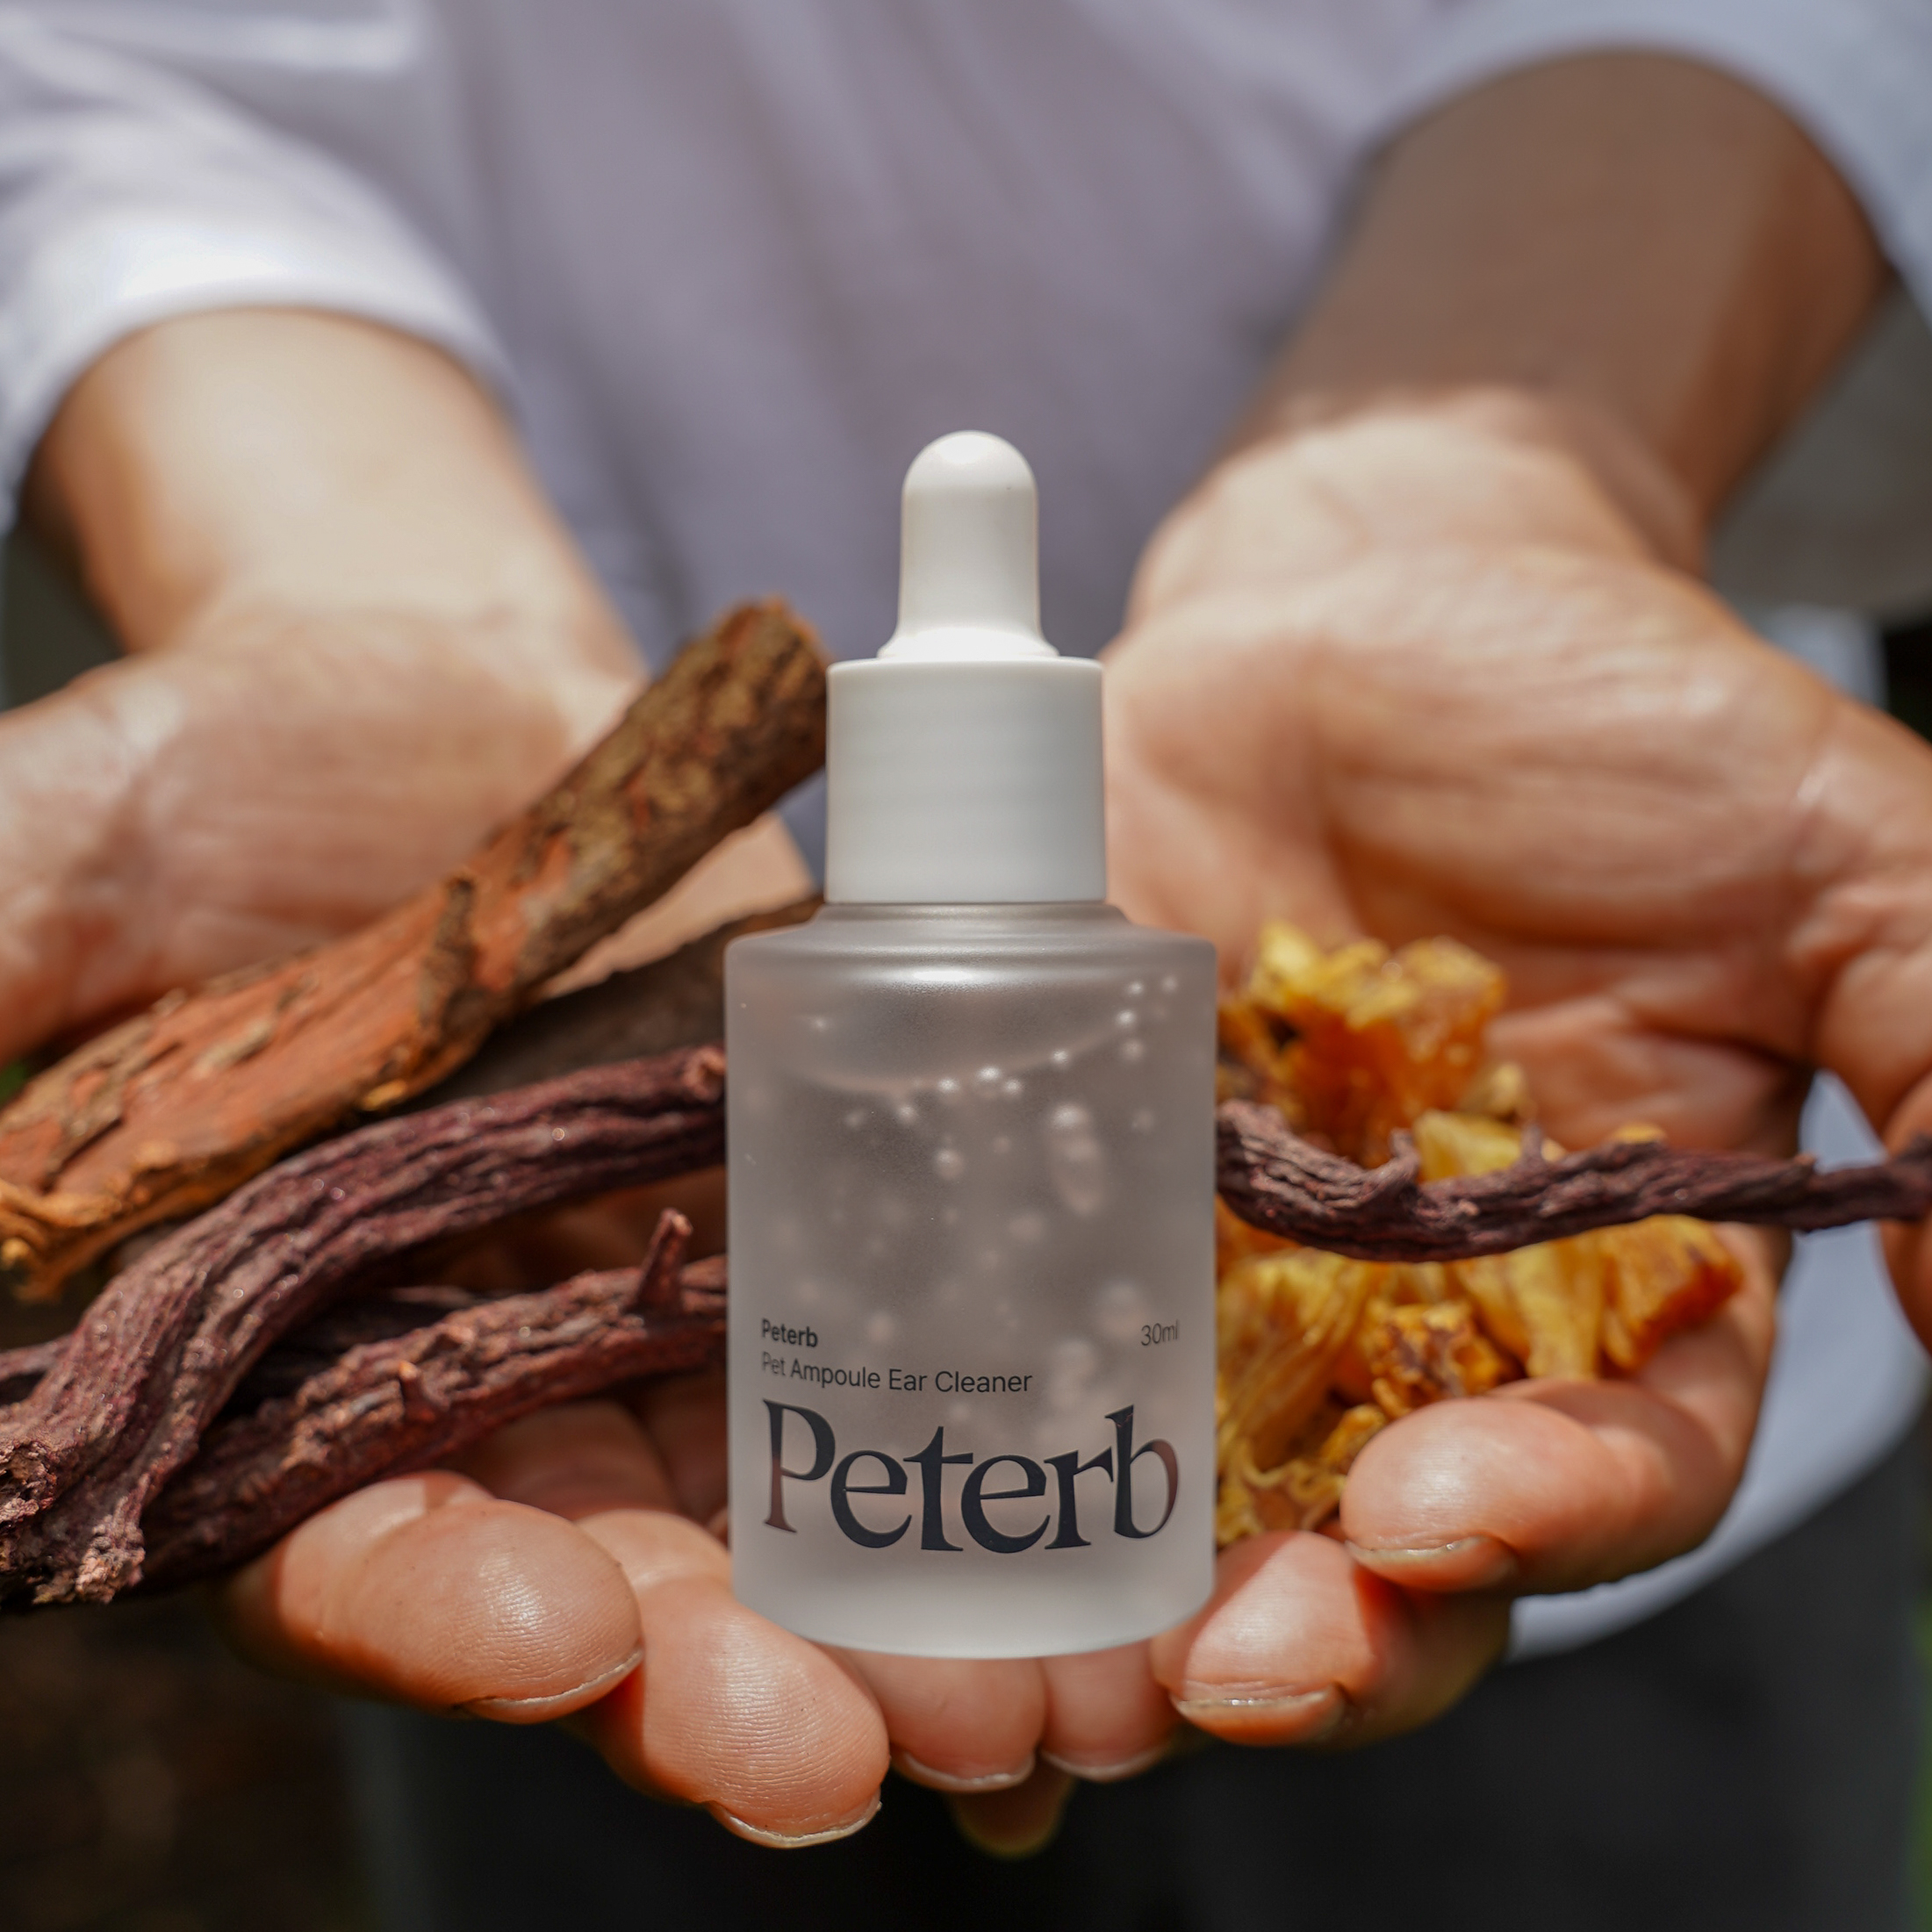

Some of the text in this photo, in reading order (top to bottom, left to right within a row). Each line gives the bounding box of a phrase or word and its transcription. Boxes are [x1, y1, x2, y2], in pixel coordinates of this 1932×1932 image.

[761, 1318, 818, 1347] Peterb
[1141, 1319, 1180, 1346] 30ml
[761, 1352, 1033, 1393] Pet Ampoule Ear Cleaner
[762, 1398, 1179, 1554] Peterb
